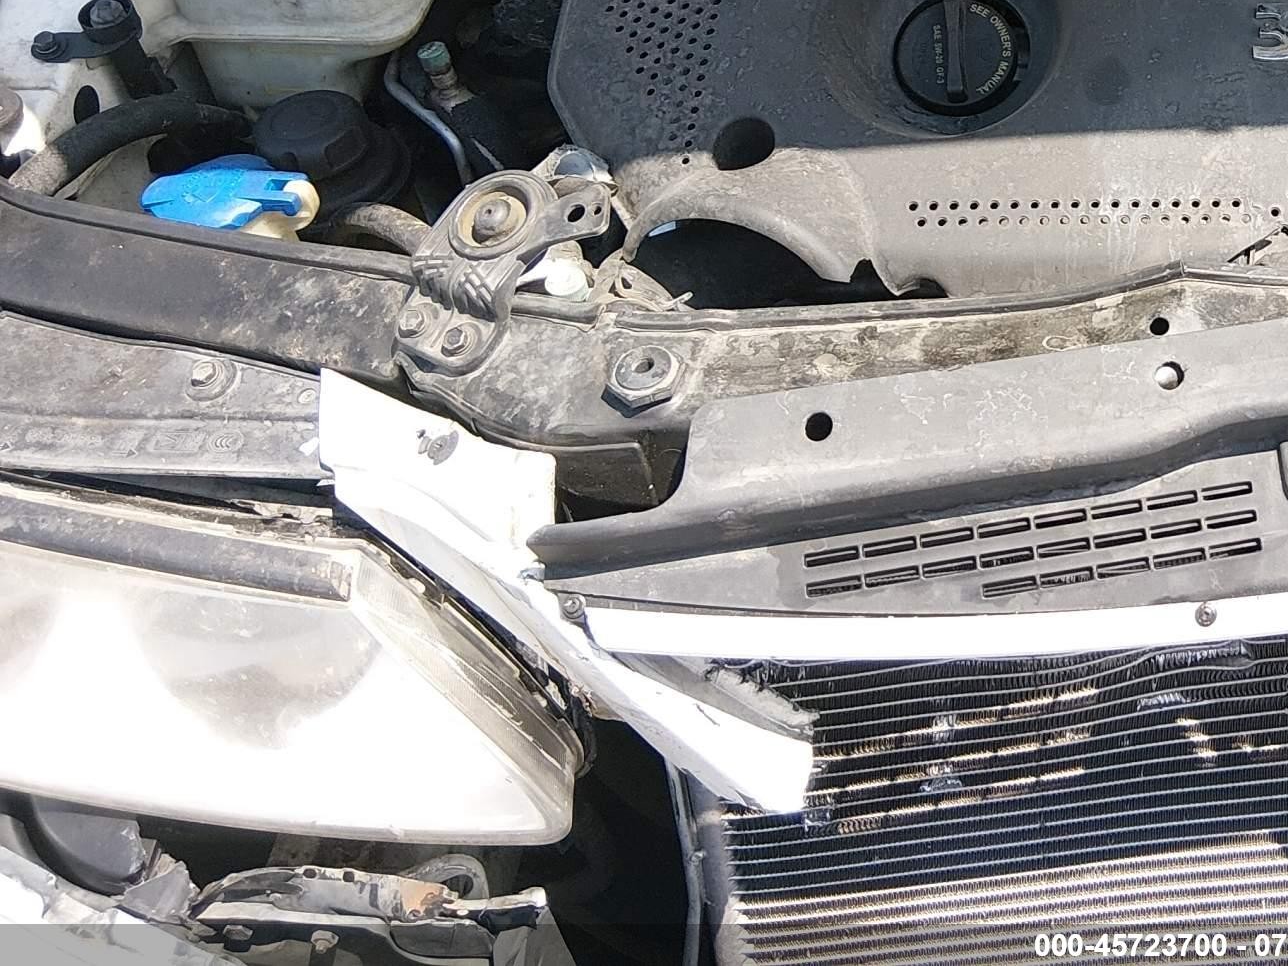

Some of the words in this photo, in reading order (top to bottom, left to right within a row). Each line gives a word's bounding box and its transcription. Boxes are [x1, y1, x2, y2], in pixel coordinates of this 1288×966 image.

[969, 3, 990, 18] SEE
[933, 25, 943, 40] SAE
[989, 15, 1012, 58] OWNER'S
[975, 60, 1009, 95] MANUAL
